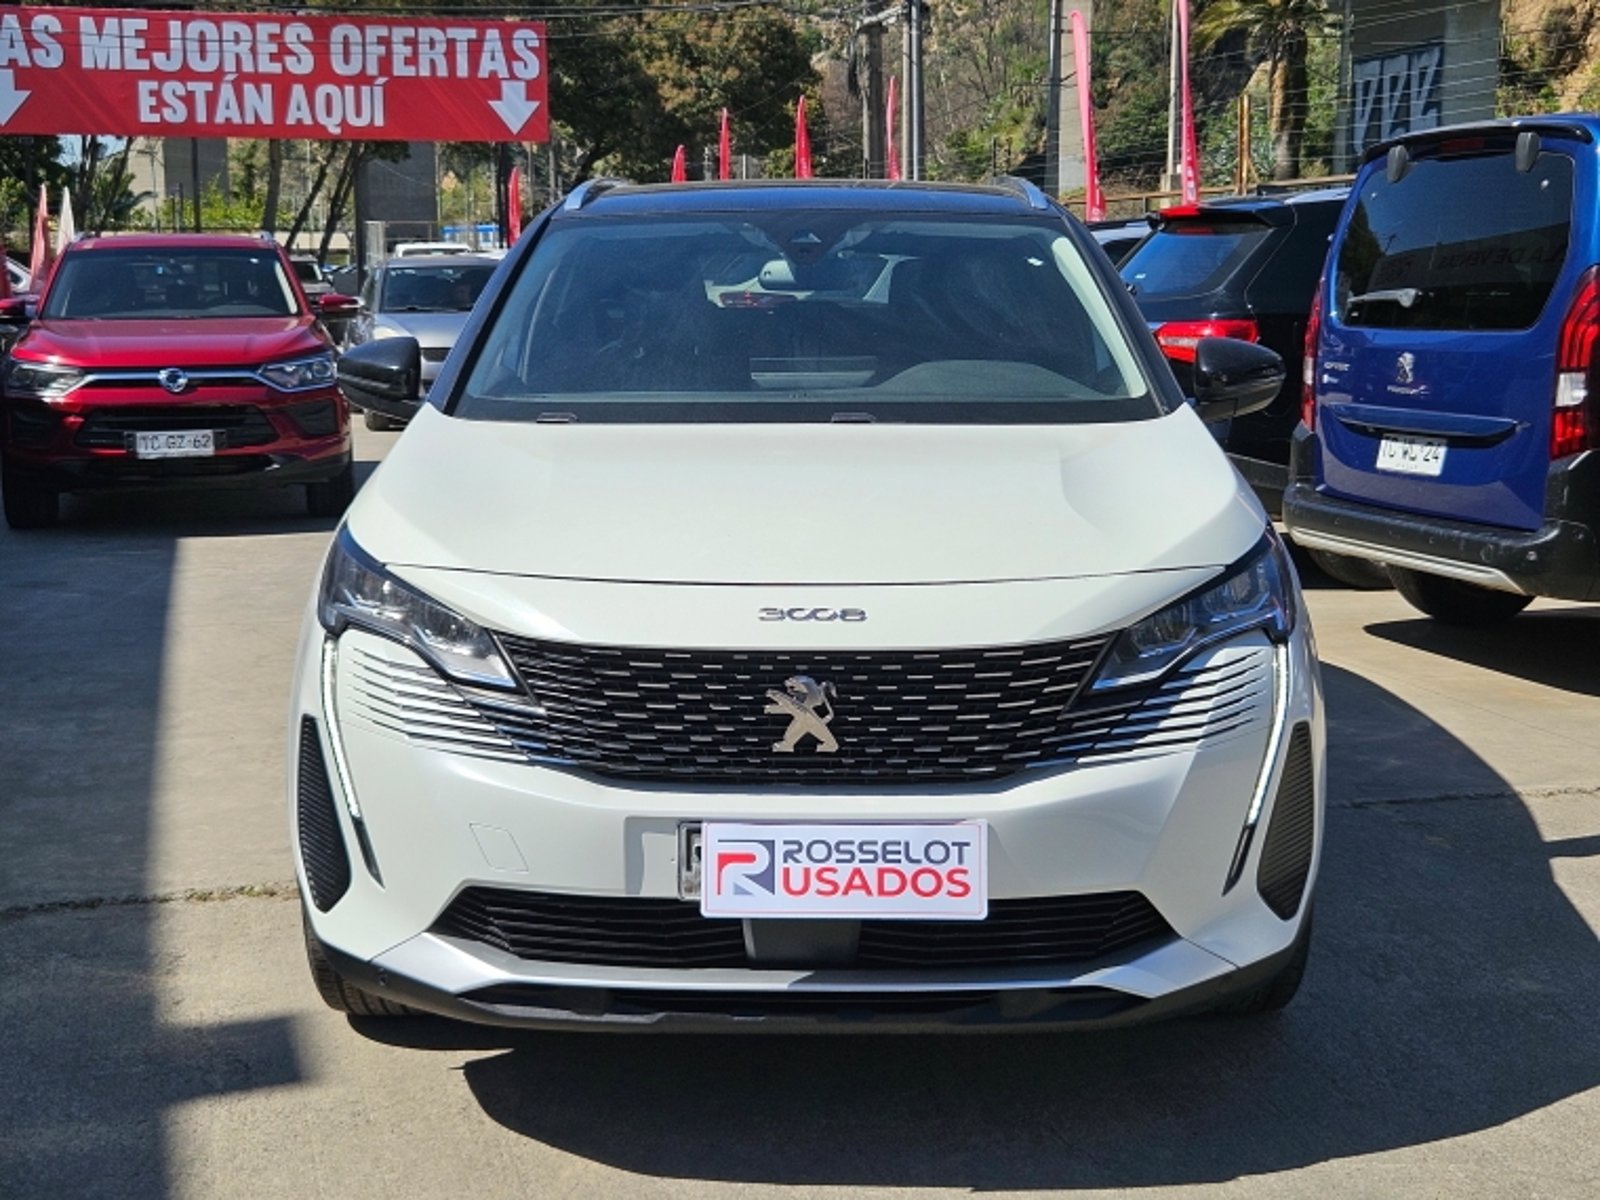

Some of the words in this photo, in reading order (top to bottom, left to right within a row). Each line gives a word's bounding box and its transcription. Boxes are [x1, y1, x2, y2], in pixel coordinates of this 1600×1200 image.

[79, 15, 316, 74] MEJORES
[329, 24, 540, 81] OFERTAS
[138, 73, 274, 126] ESTÁN
[286, 77, 389, 134] AQUÍ
[758, 607, 867, 621] 3008
[782, 839, 971, 866] ROSSELOT
[782, 867, 971, 898] USADOS
